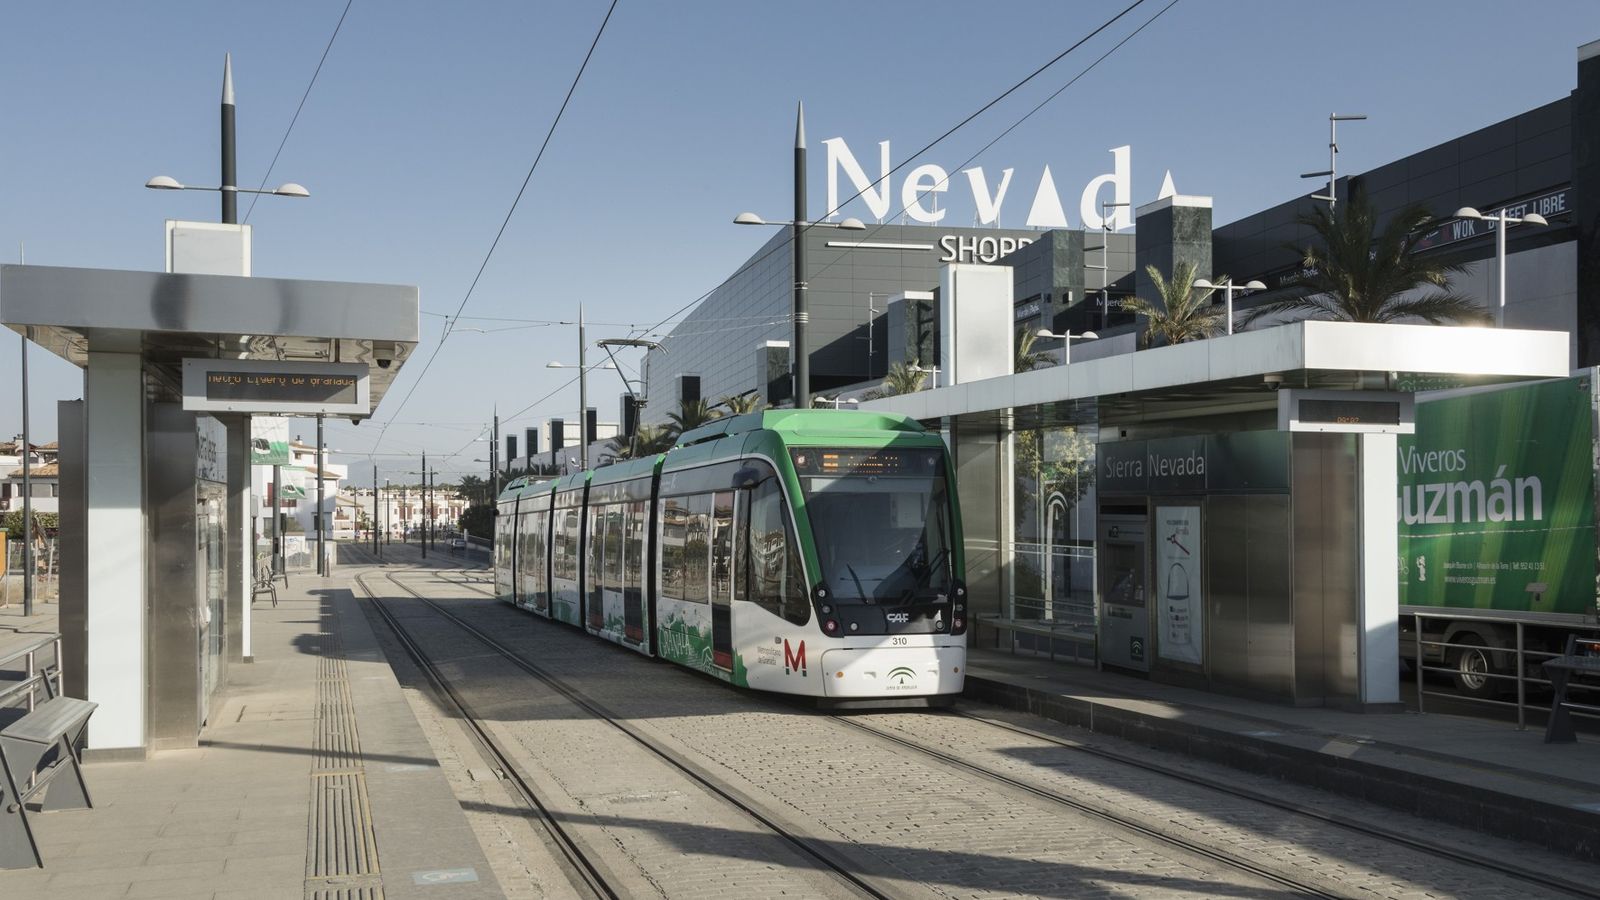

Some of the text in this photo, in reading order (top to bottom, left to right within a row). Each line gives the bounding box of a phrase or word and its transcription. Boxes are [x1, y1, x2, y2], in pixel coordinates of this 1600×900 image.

[1452, 219, 1475, 240] WOK
[1105, 450, 1205, 479] Sierra Nevada
[1399, 445, 1466, 475] Viveros
[1397, 464, 1543, 526] uzmán
[892, 637, 907, 646] 310
[784, 638, 807, 677] M
